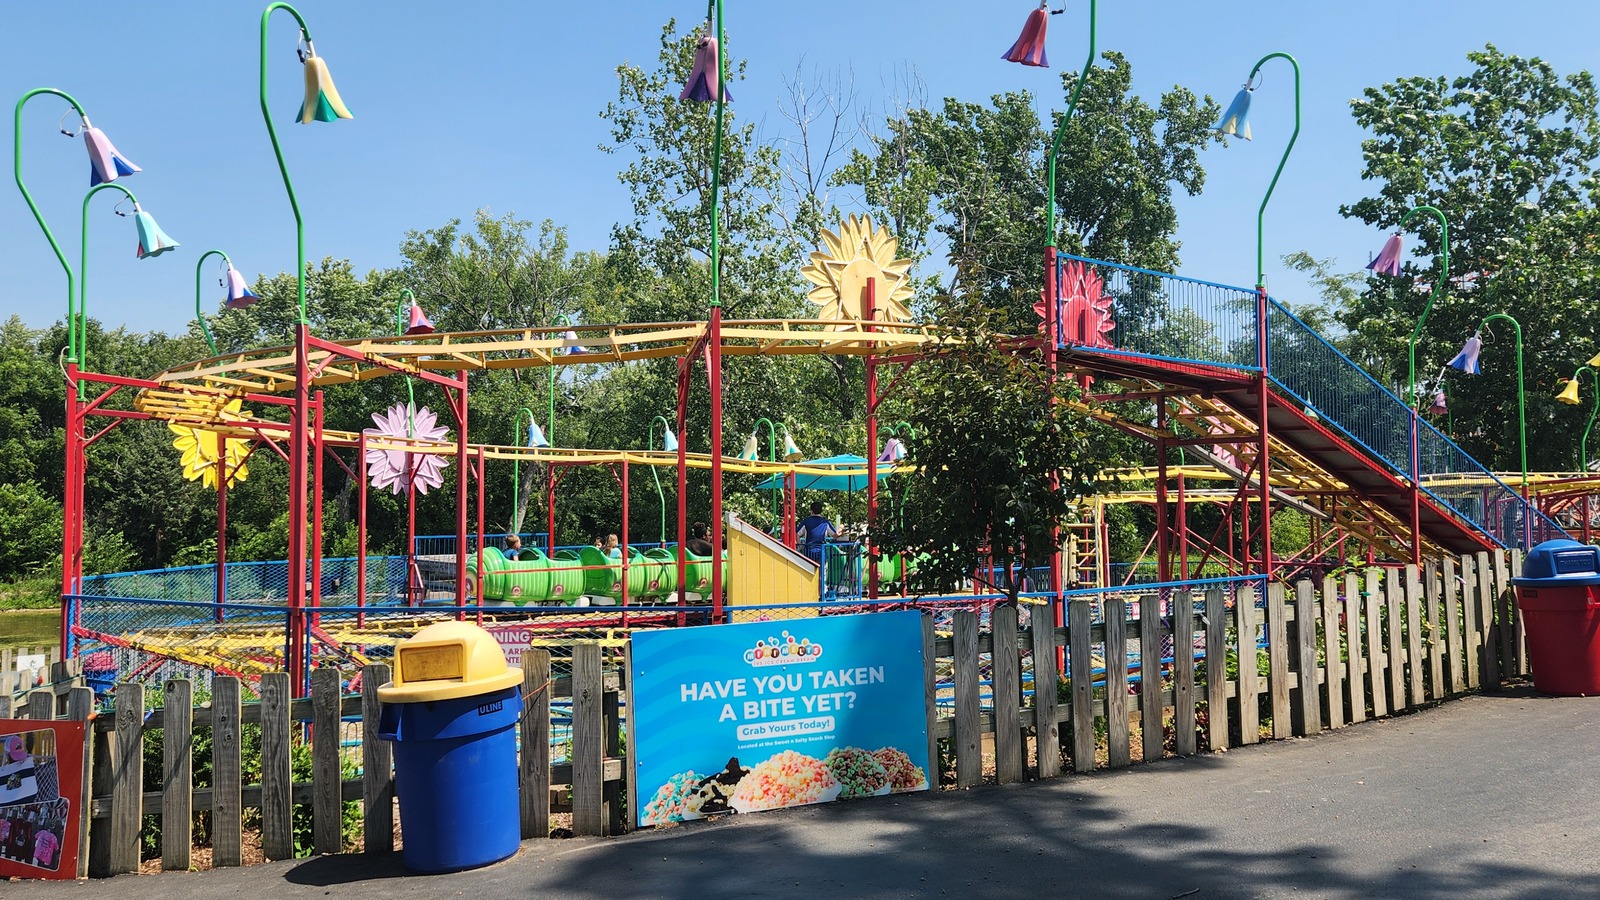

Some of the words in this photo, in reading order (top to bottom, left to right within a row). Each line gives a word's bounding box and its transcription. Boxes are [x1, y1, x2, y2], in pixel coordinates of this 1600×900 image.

[493, 631, 530, 643] NING
[745, 646, 780, 661] MINI
[781, 643, 821, 657] MELTS
[680, 678, 747, 702] HAVE
[752, 673, 803, 695] YOU
[808, 666, 885, 690] TAKEN
[479, 701, 502, 714] ULINE
[718, 703, 737, 722] A
[744, 698, 796, 720] BITE
[801, 691, 857, 714] YET?
[742, 726, 766, 736] Grab
[769, 723, 796, 733] Yours
[798, 720, 830, 730] Today!
